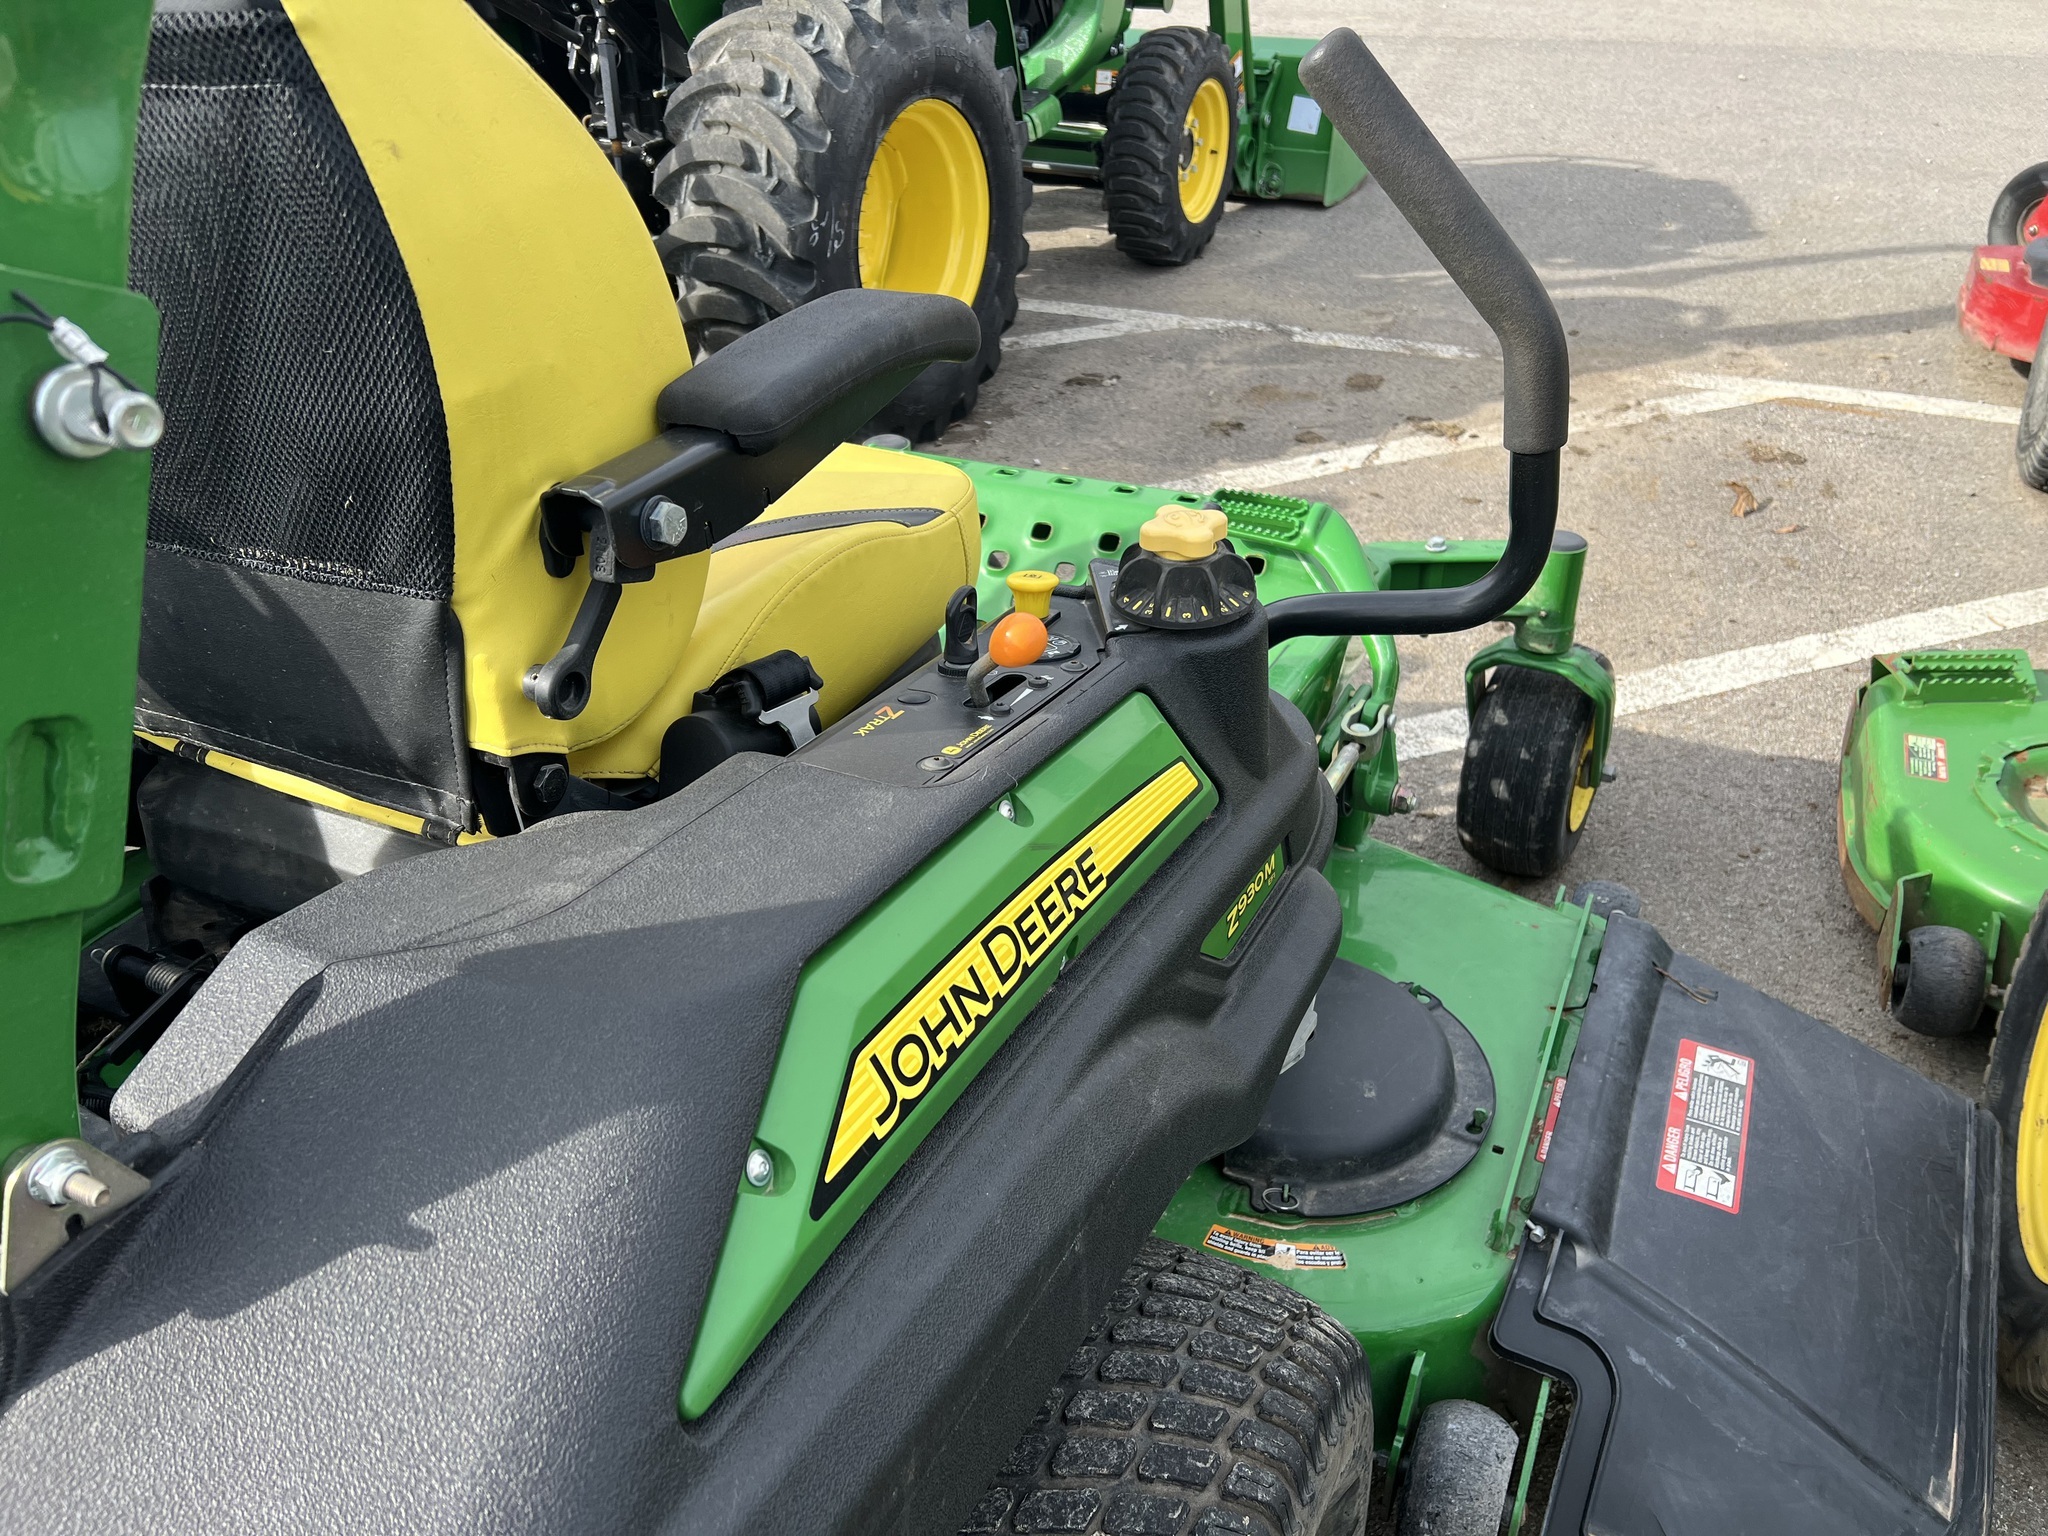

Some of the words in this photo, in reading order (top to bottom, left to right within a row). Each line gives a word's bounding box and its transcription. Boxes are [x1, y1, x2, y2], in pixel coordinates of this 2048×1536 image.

[1226, 853, 1276, 939] Z930M
[868, 963, 992, 1128] JOHN
[980, 846, 1106, 991] DEERE
[1675, 1057, 1693, 1092] PELIGRO
[1664, 1126, 1681, 1162] DANGER
[1233, 1231, 1265, 1244] WARNING
